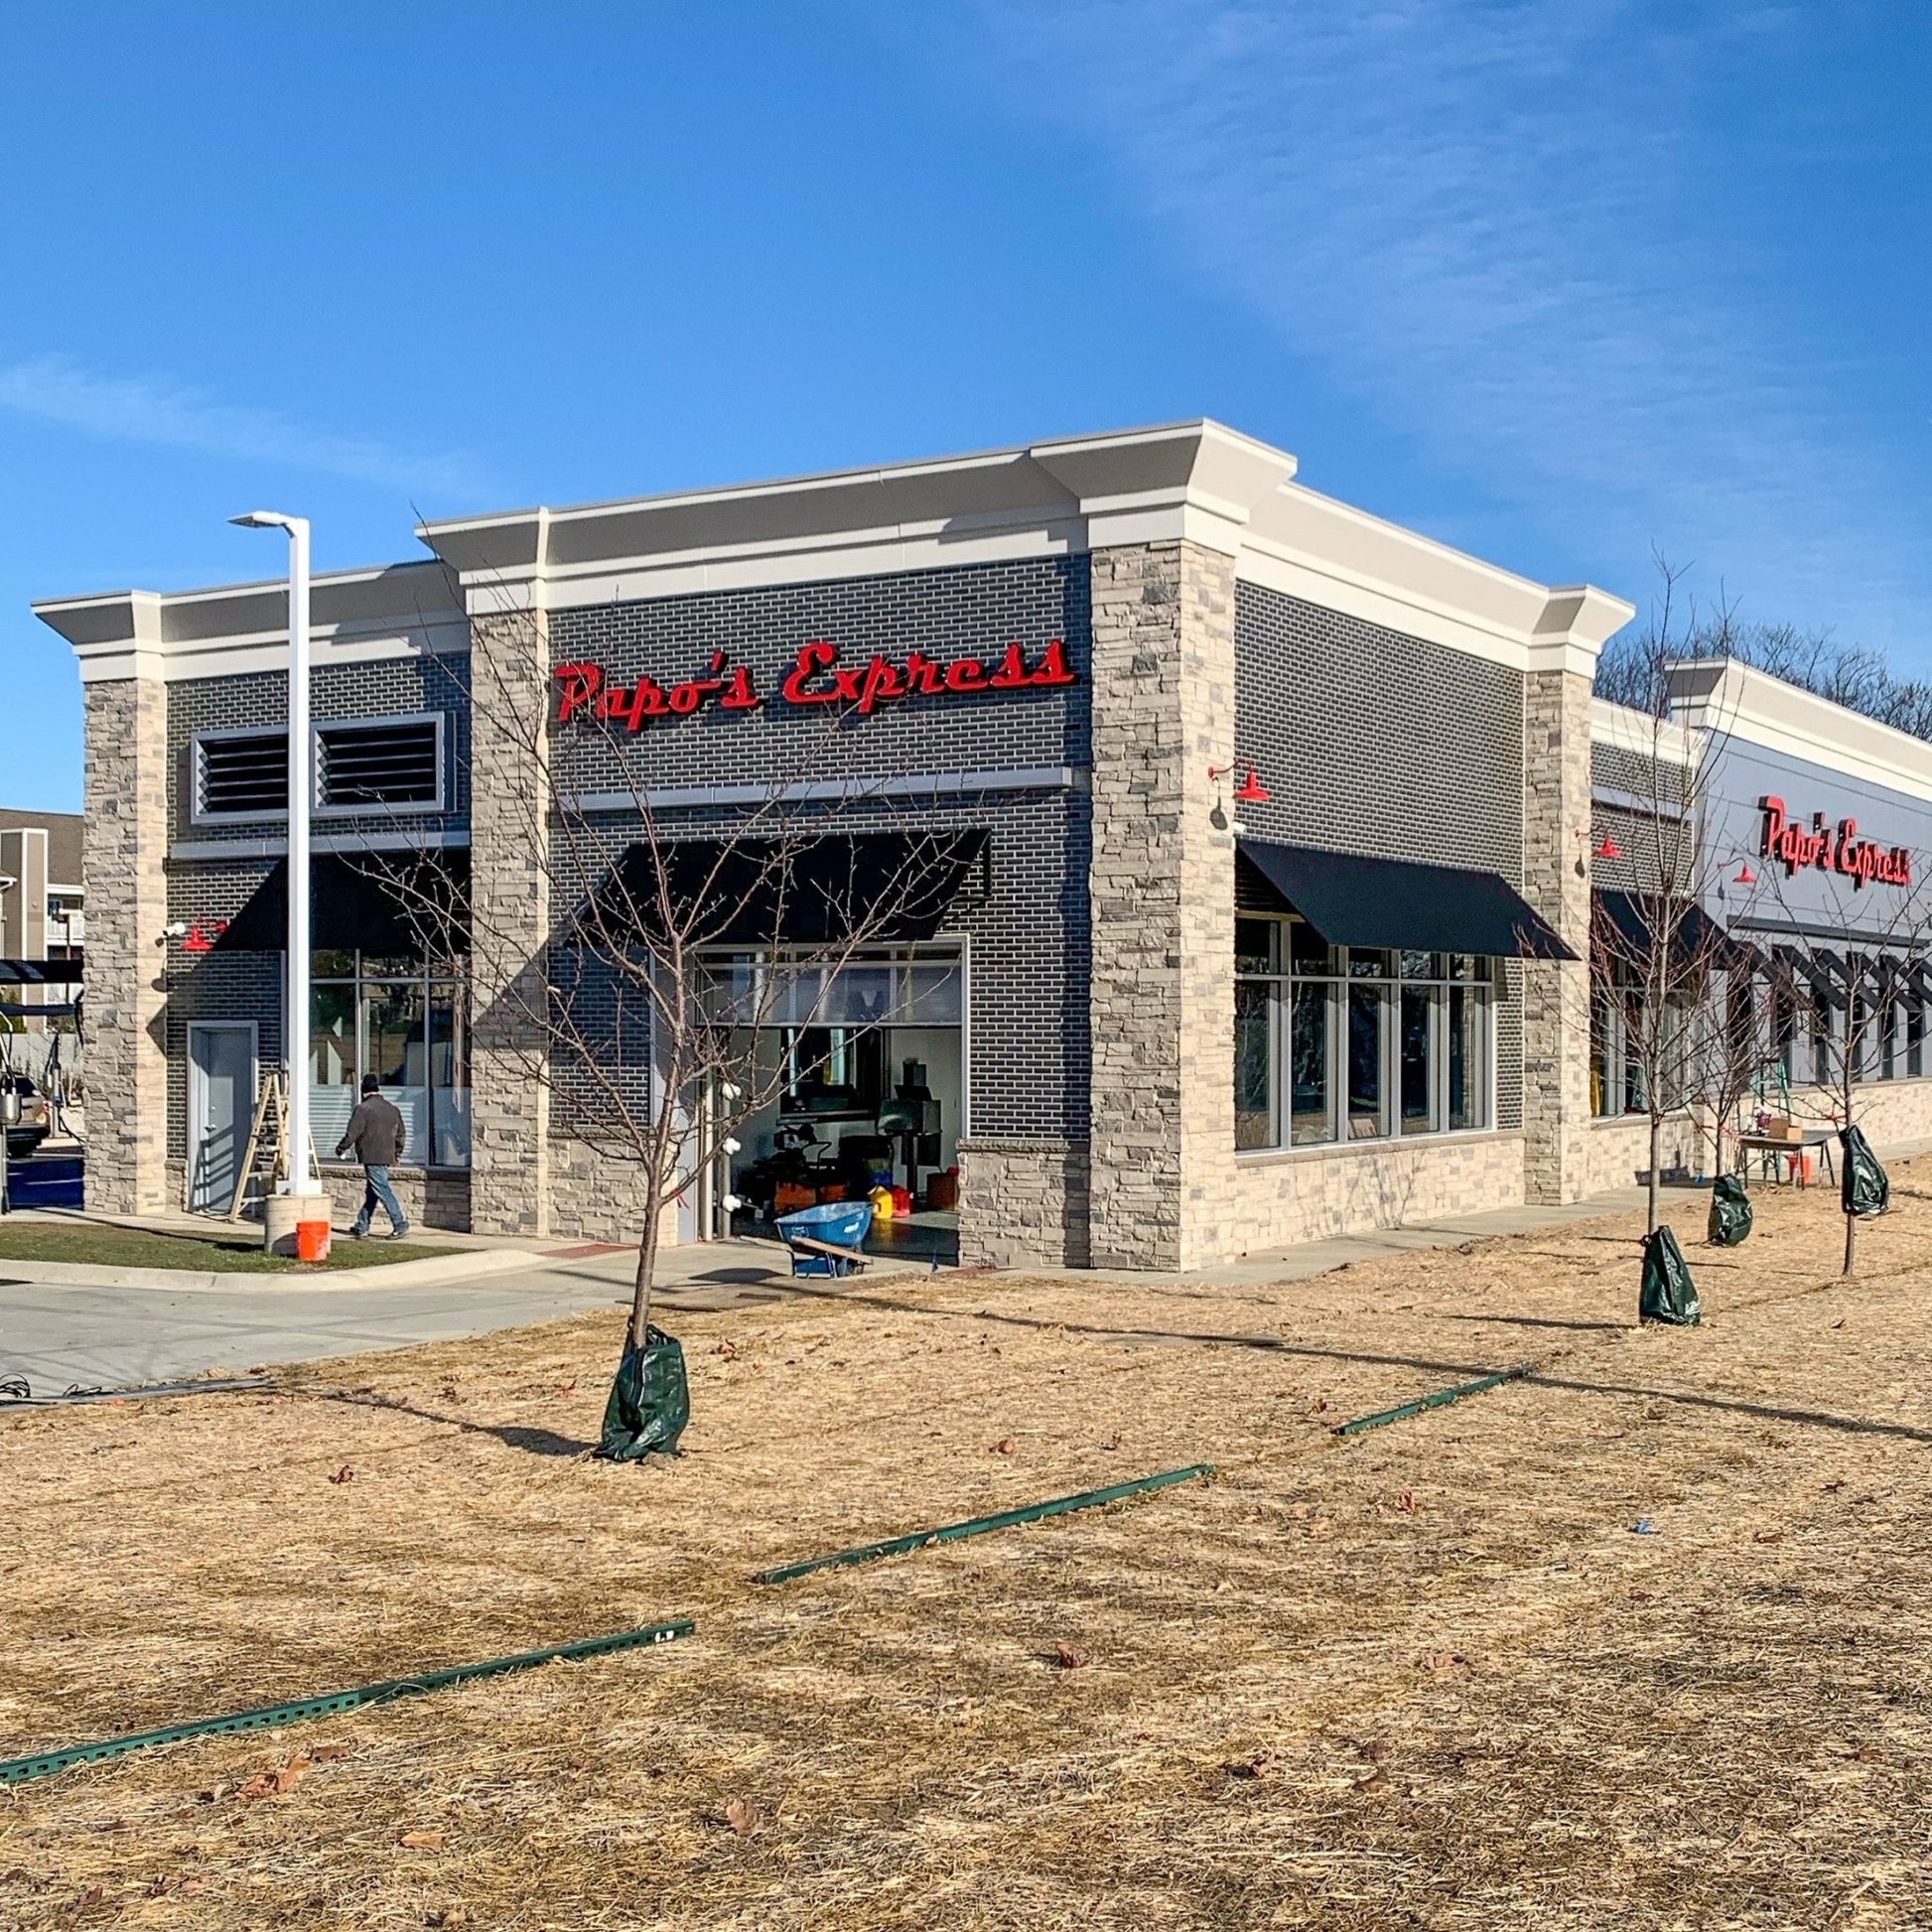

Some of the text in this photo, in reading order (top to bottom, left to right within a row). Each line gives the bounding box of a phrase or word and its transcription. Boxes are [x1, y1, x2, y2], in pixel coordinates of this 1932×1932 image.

[553, 639, 1075, 733] Papo's Express
[1758, 795, 1912, 892] Papo's Express
